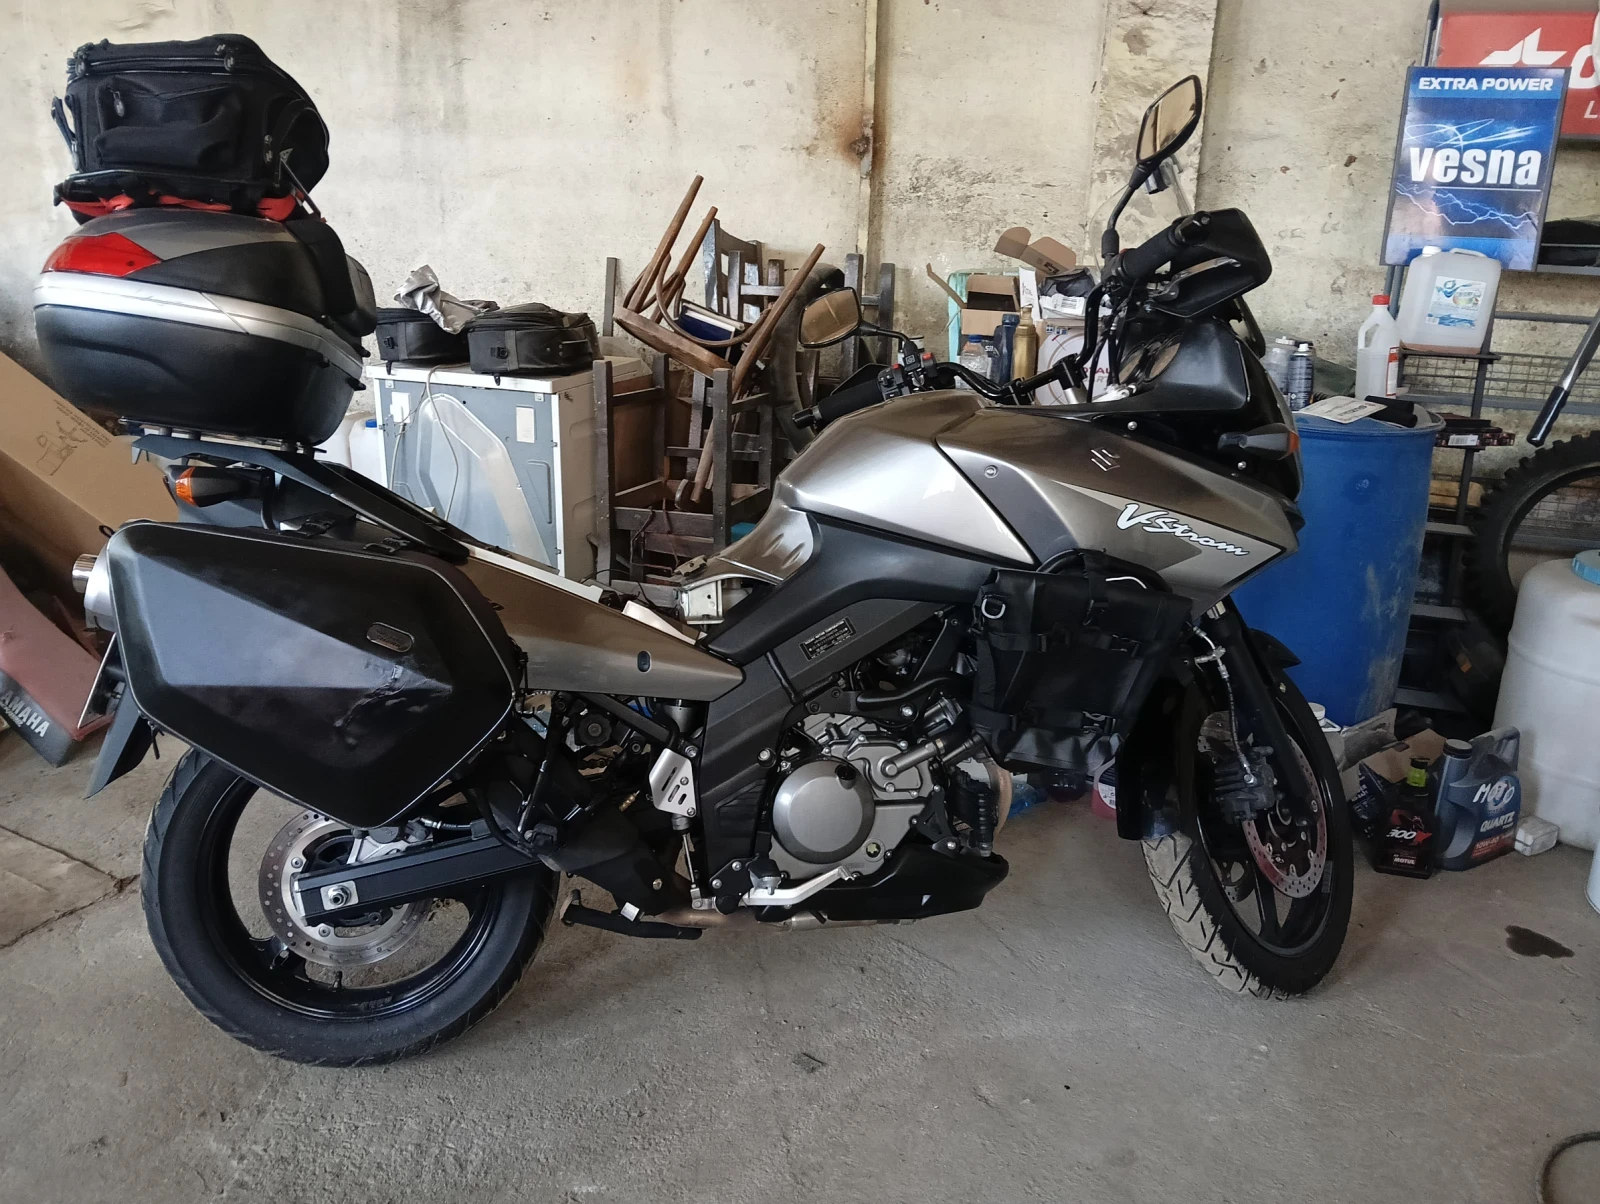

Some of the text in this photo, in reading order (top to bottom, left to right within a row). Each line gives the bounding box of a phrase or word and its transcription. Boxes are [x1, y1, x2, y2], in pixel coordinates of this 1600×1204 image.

[1418, 77, 1554, 91] EXTRA POWER
[1409, 147, 1542, 186] vesna
[1116, 503, 1250, 556] V-Strom
[0, 690, 50, 738] AMAHA
[1480, 811, 1515, 832] QUARTZ
[1393, 857, 1416, 865] MOTUL
